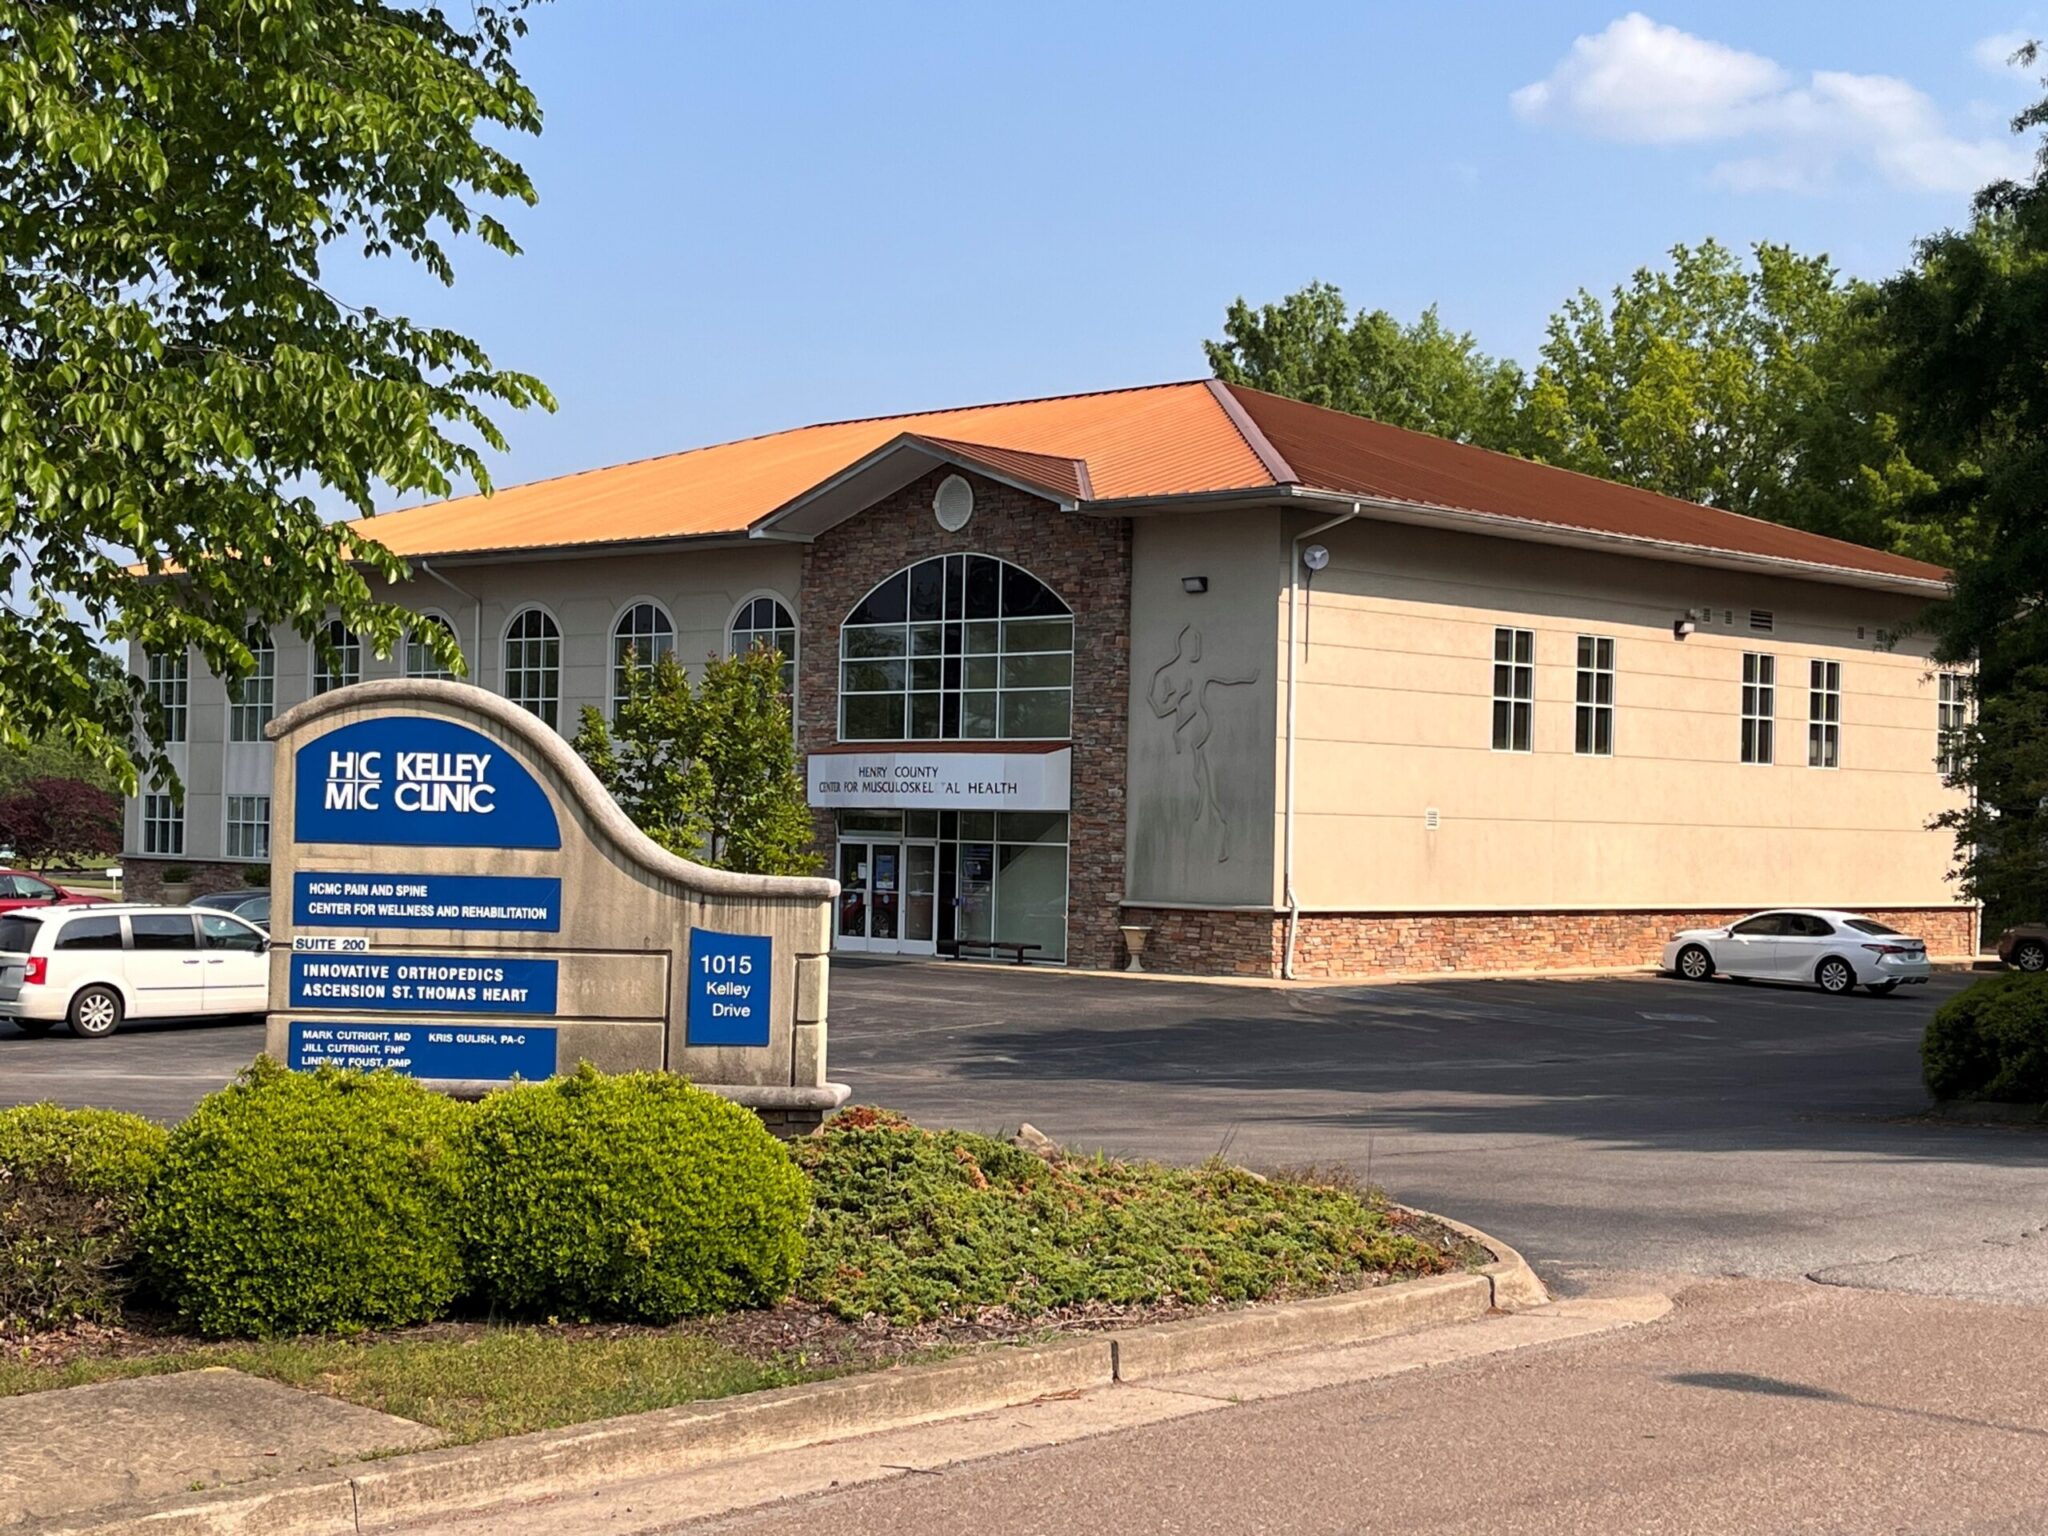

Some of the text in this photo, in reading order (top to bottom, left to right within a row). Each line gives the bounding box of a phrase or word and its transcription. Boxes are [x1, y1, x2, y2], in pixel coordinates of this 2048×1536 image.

[330, 751, 492, 782] HC KELLEY
[859, 766, 939, 778] HENRY COUNTY
[819, 781, 841, 793] CENTER
[843, 782, 858, 793] FOR
[968, 782, 1018, 794] HEALTH
[325, 782, 496, 813] MC CLINIC
[309, 882, 428, 897] HCMC PAIN AND SPINE
[308, 902, 547, 920] CENTER FOR WELLNESS AND REHABILITATION
[296, 938, 366, 951] SUITE 200
[701, 954, 752, 974] 1015
[303, 964, 503, 981] INNOVATIVE ORTHOPEDICS
[303, 983, 528, 1002] ASCENSION ST. THOMAS HEART
[706, 981, 751, 999] Kelley
[712, 1002, 751, 1017] Drive
[302, 1030, 411, 1042] MARK CUTRIGHT, MD
[428, 1033, 525, 1045] KRIS GULISH, PA-C
[302, 1043, 405, 1055] JILL CUTRIGHT, FNP
[301, 1056, 345, 1066] LINDAY
[387, 1058, 411, 1068] DMP
